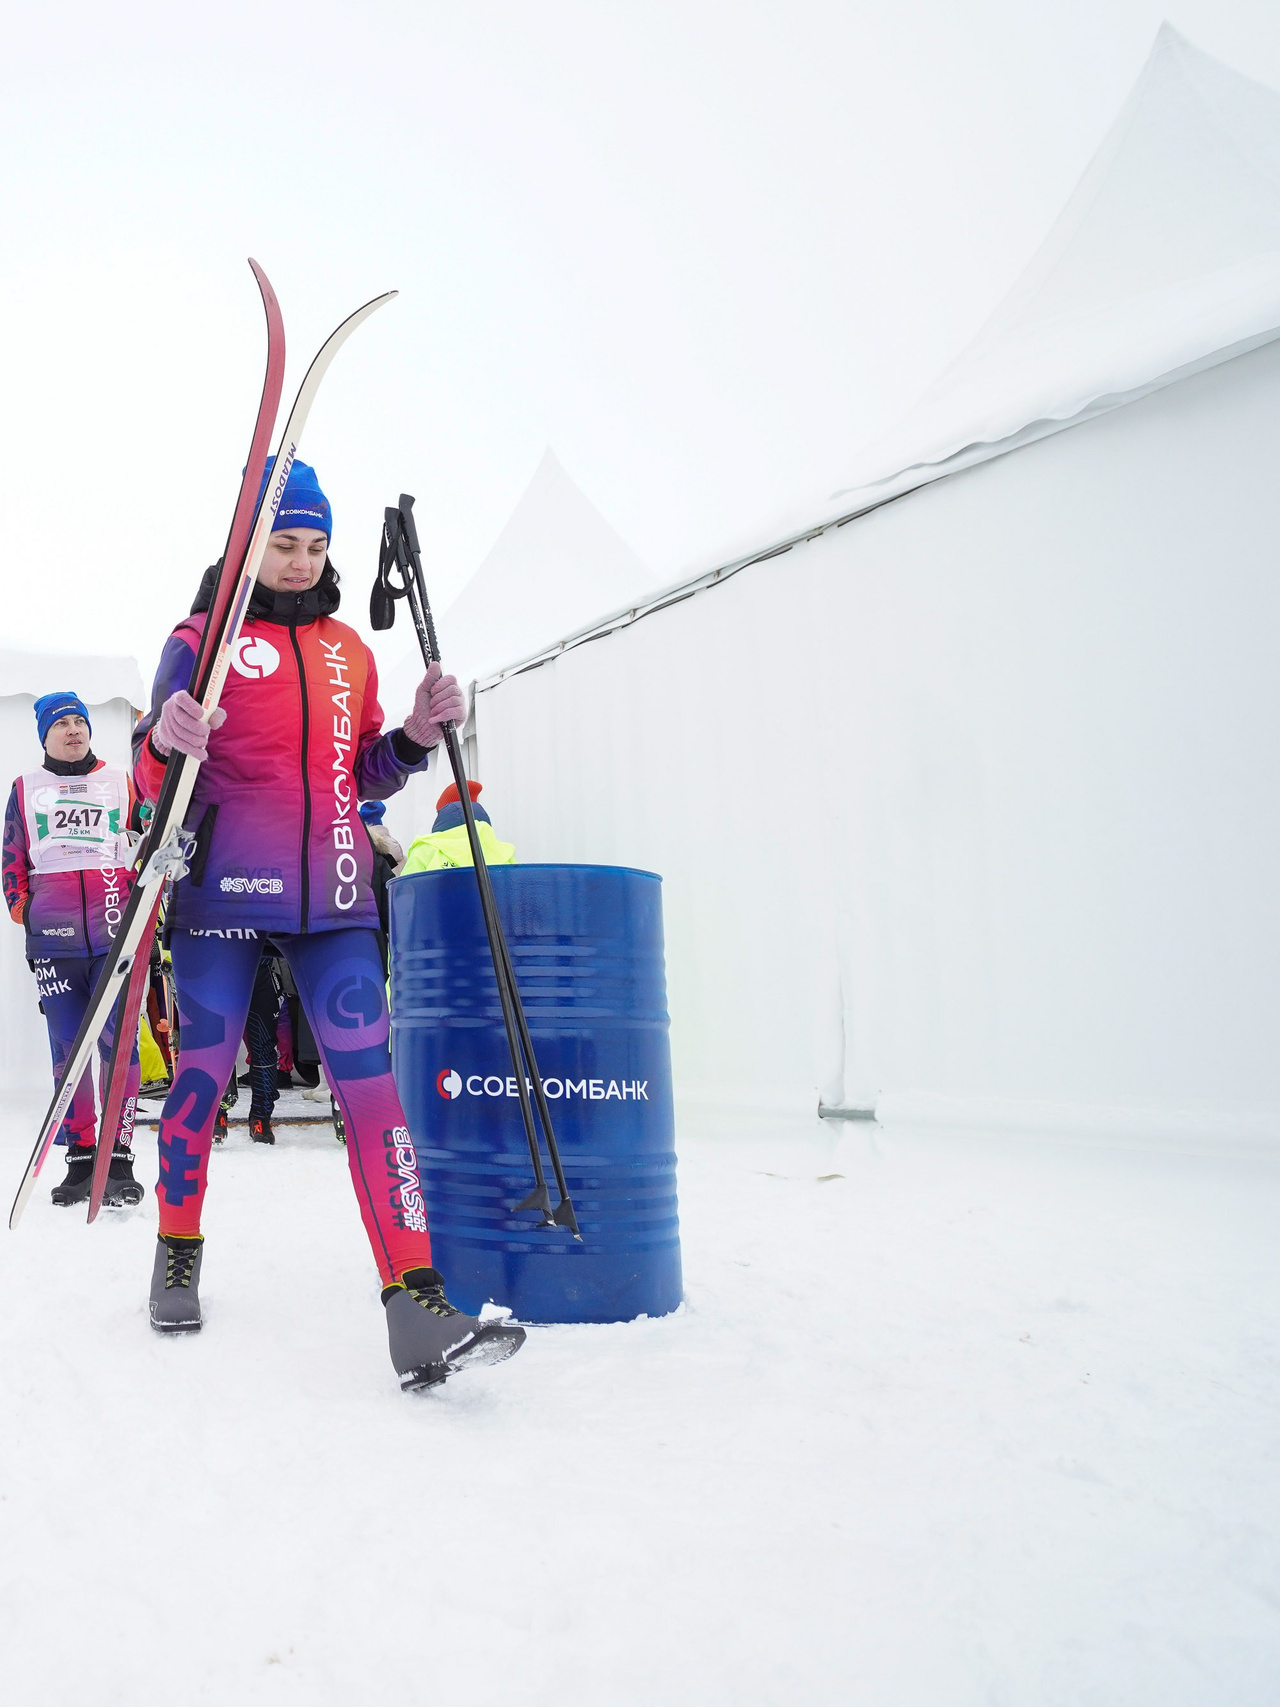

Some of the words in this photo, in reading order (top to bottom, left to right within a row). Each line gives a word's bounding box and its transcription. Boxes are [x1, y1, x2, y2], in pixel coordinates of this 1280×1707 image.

[269, 441, 297, 517] MLADOST
[319, 637, 358, 911] СОВКОМБАНК
[54, 808, 103, 829] 2417
[219, 876, 284, 894] #SVCB
[393, 1126, 427, 1233] #SVCB
